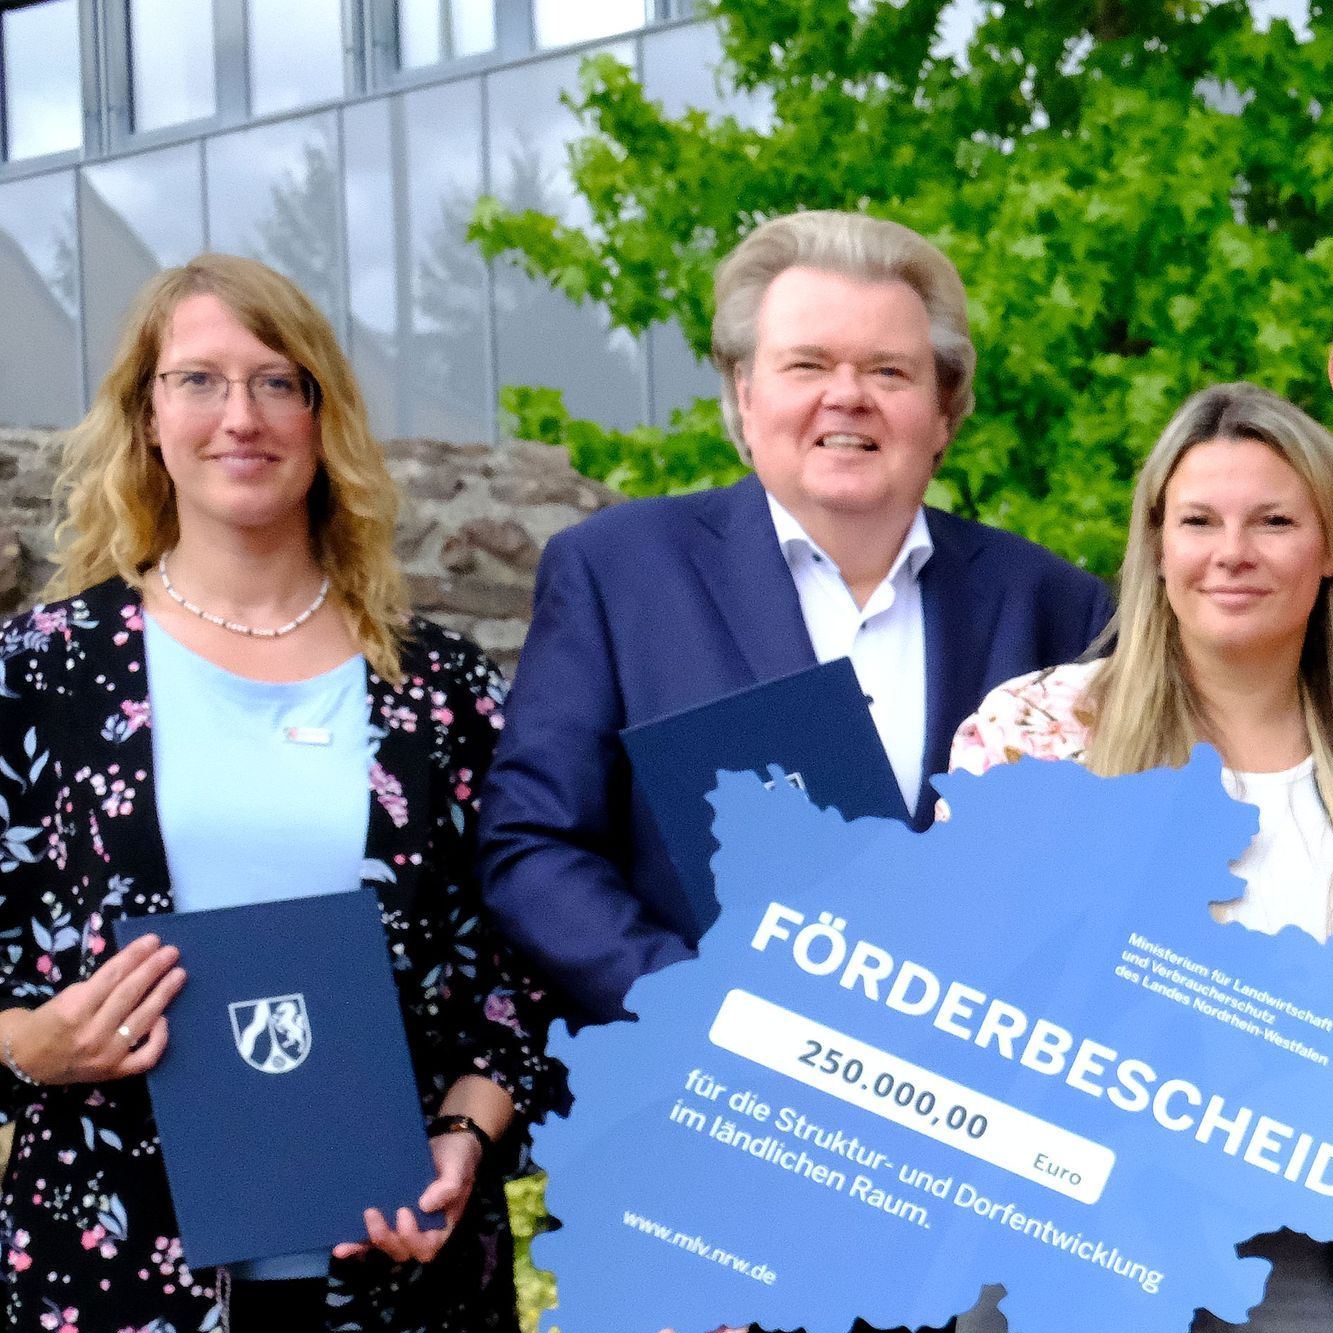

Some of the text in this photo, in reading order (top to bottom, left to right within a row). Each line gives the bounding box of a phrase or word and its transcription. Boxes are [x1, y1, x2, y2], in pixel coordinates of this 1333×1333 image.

[1115, 966, 1328, 1065] des Landes Nordrhein-Westfalen
[1122, 951, 1275, 1024] und Verbraucherschutz
[1129, 933, 1333, 1032] Ministerium für Landwirtschaft
[798, 1040, 1081, 1185] 250.000,00 Euro
[670, 1100, 929, 1228] im ländlichen Raum.
[685, 1069, 1164, 1293] für die Struktur- und Dorfentwicklung
[624, 1211, 776, 1285] www.mlv.nrw.de
